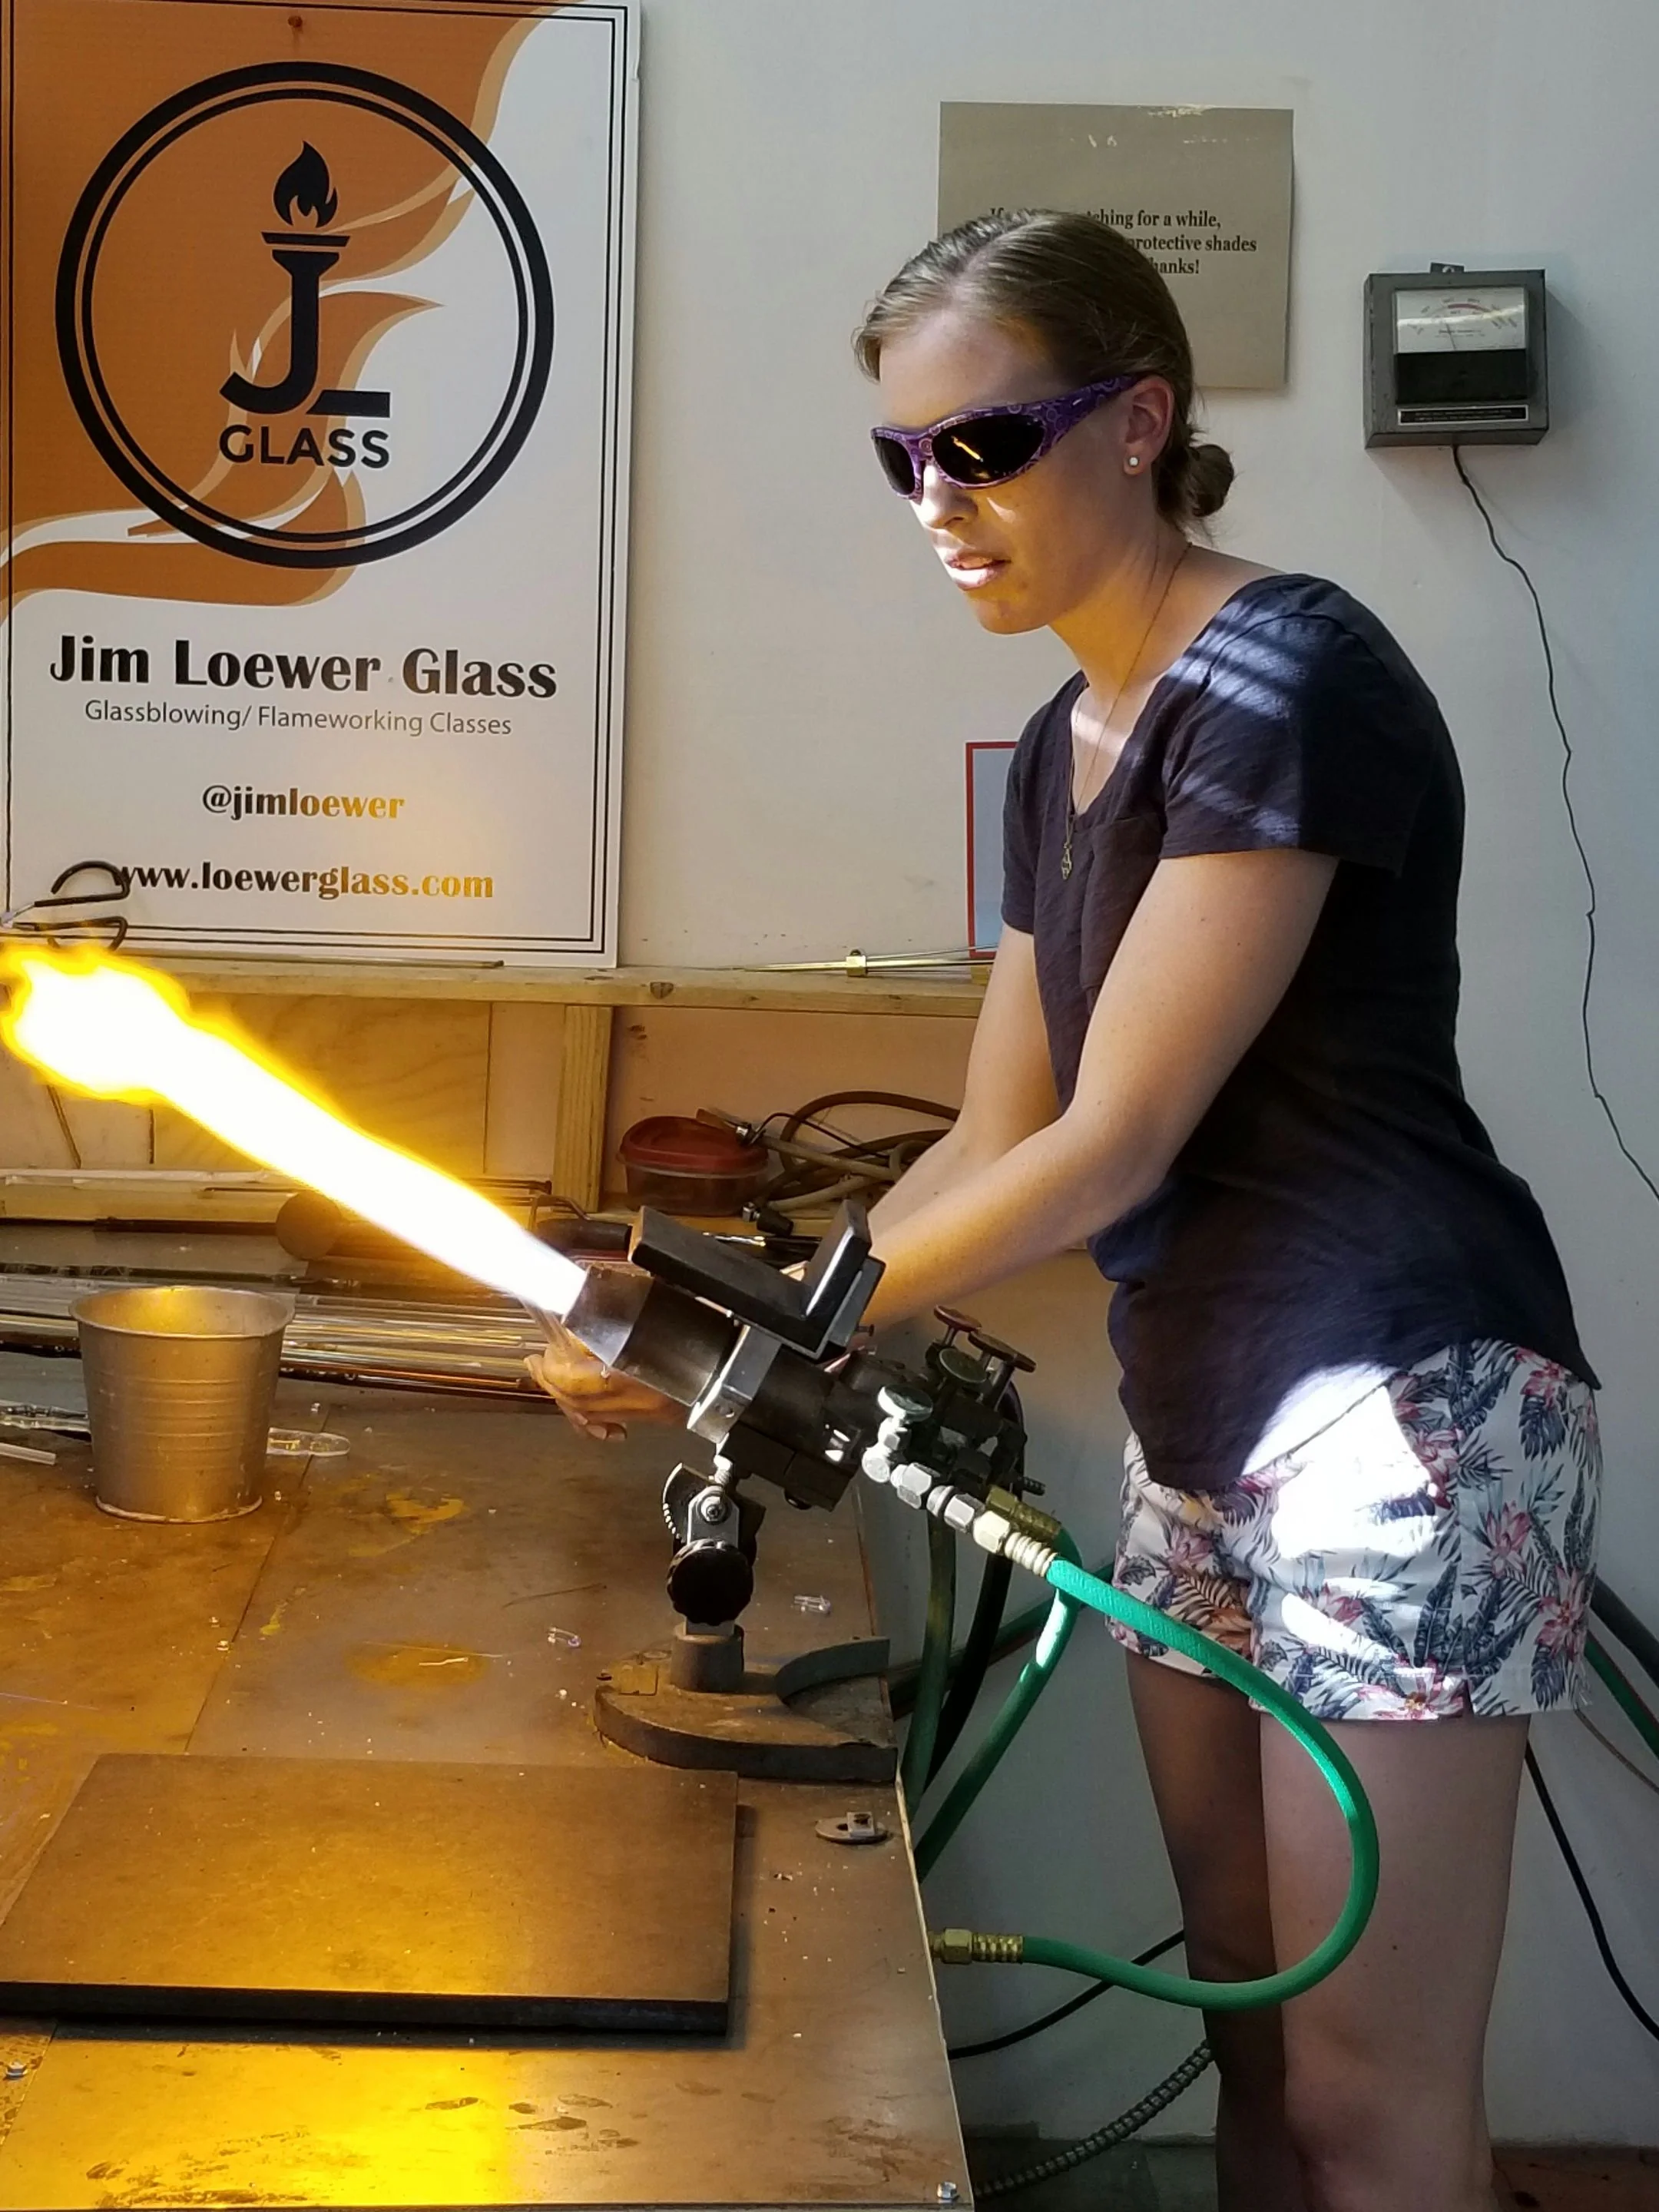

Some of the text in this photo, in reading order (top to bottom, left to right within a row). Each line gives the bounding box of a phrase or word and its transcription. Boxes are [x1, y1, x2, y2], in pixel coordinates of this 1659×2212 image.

[1137, 210, 1160, 227] for
[1163, 212, 1172, 227] a
[1176, 210, 1222, 229] while,
[1204, 234, 1257, 252] shades
[1148, 256, 1200, 274] hanks!
[219, 424, 390, 469] GLASS
[50, 634, 558, 699] Jim Loewer Glass
[84, 699, 512, 738] Glassblowing/ Flameworking Classes
[202, 784, 406, 821] @jimloewer
[111, 861, 495, 901] www.loewerglass.com
